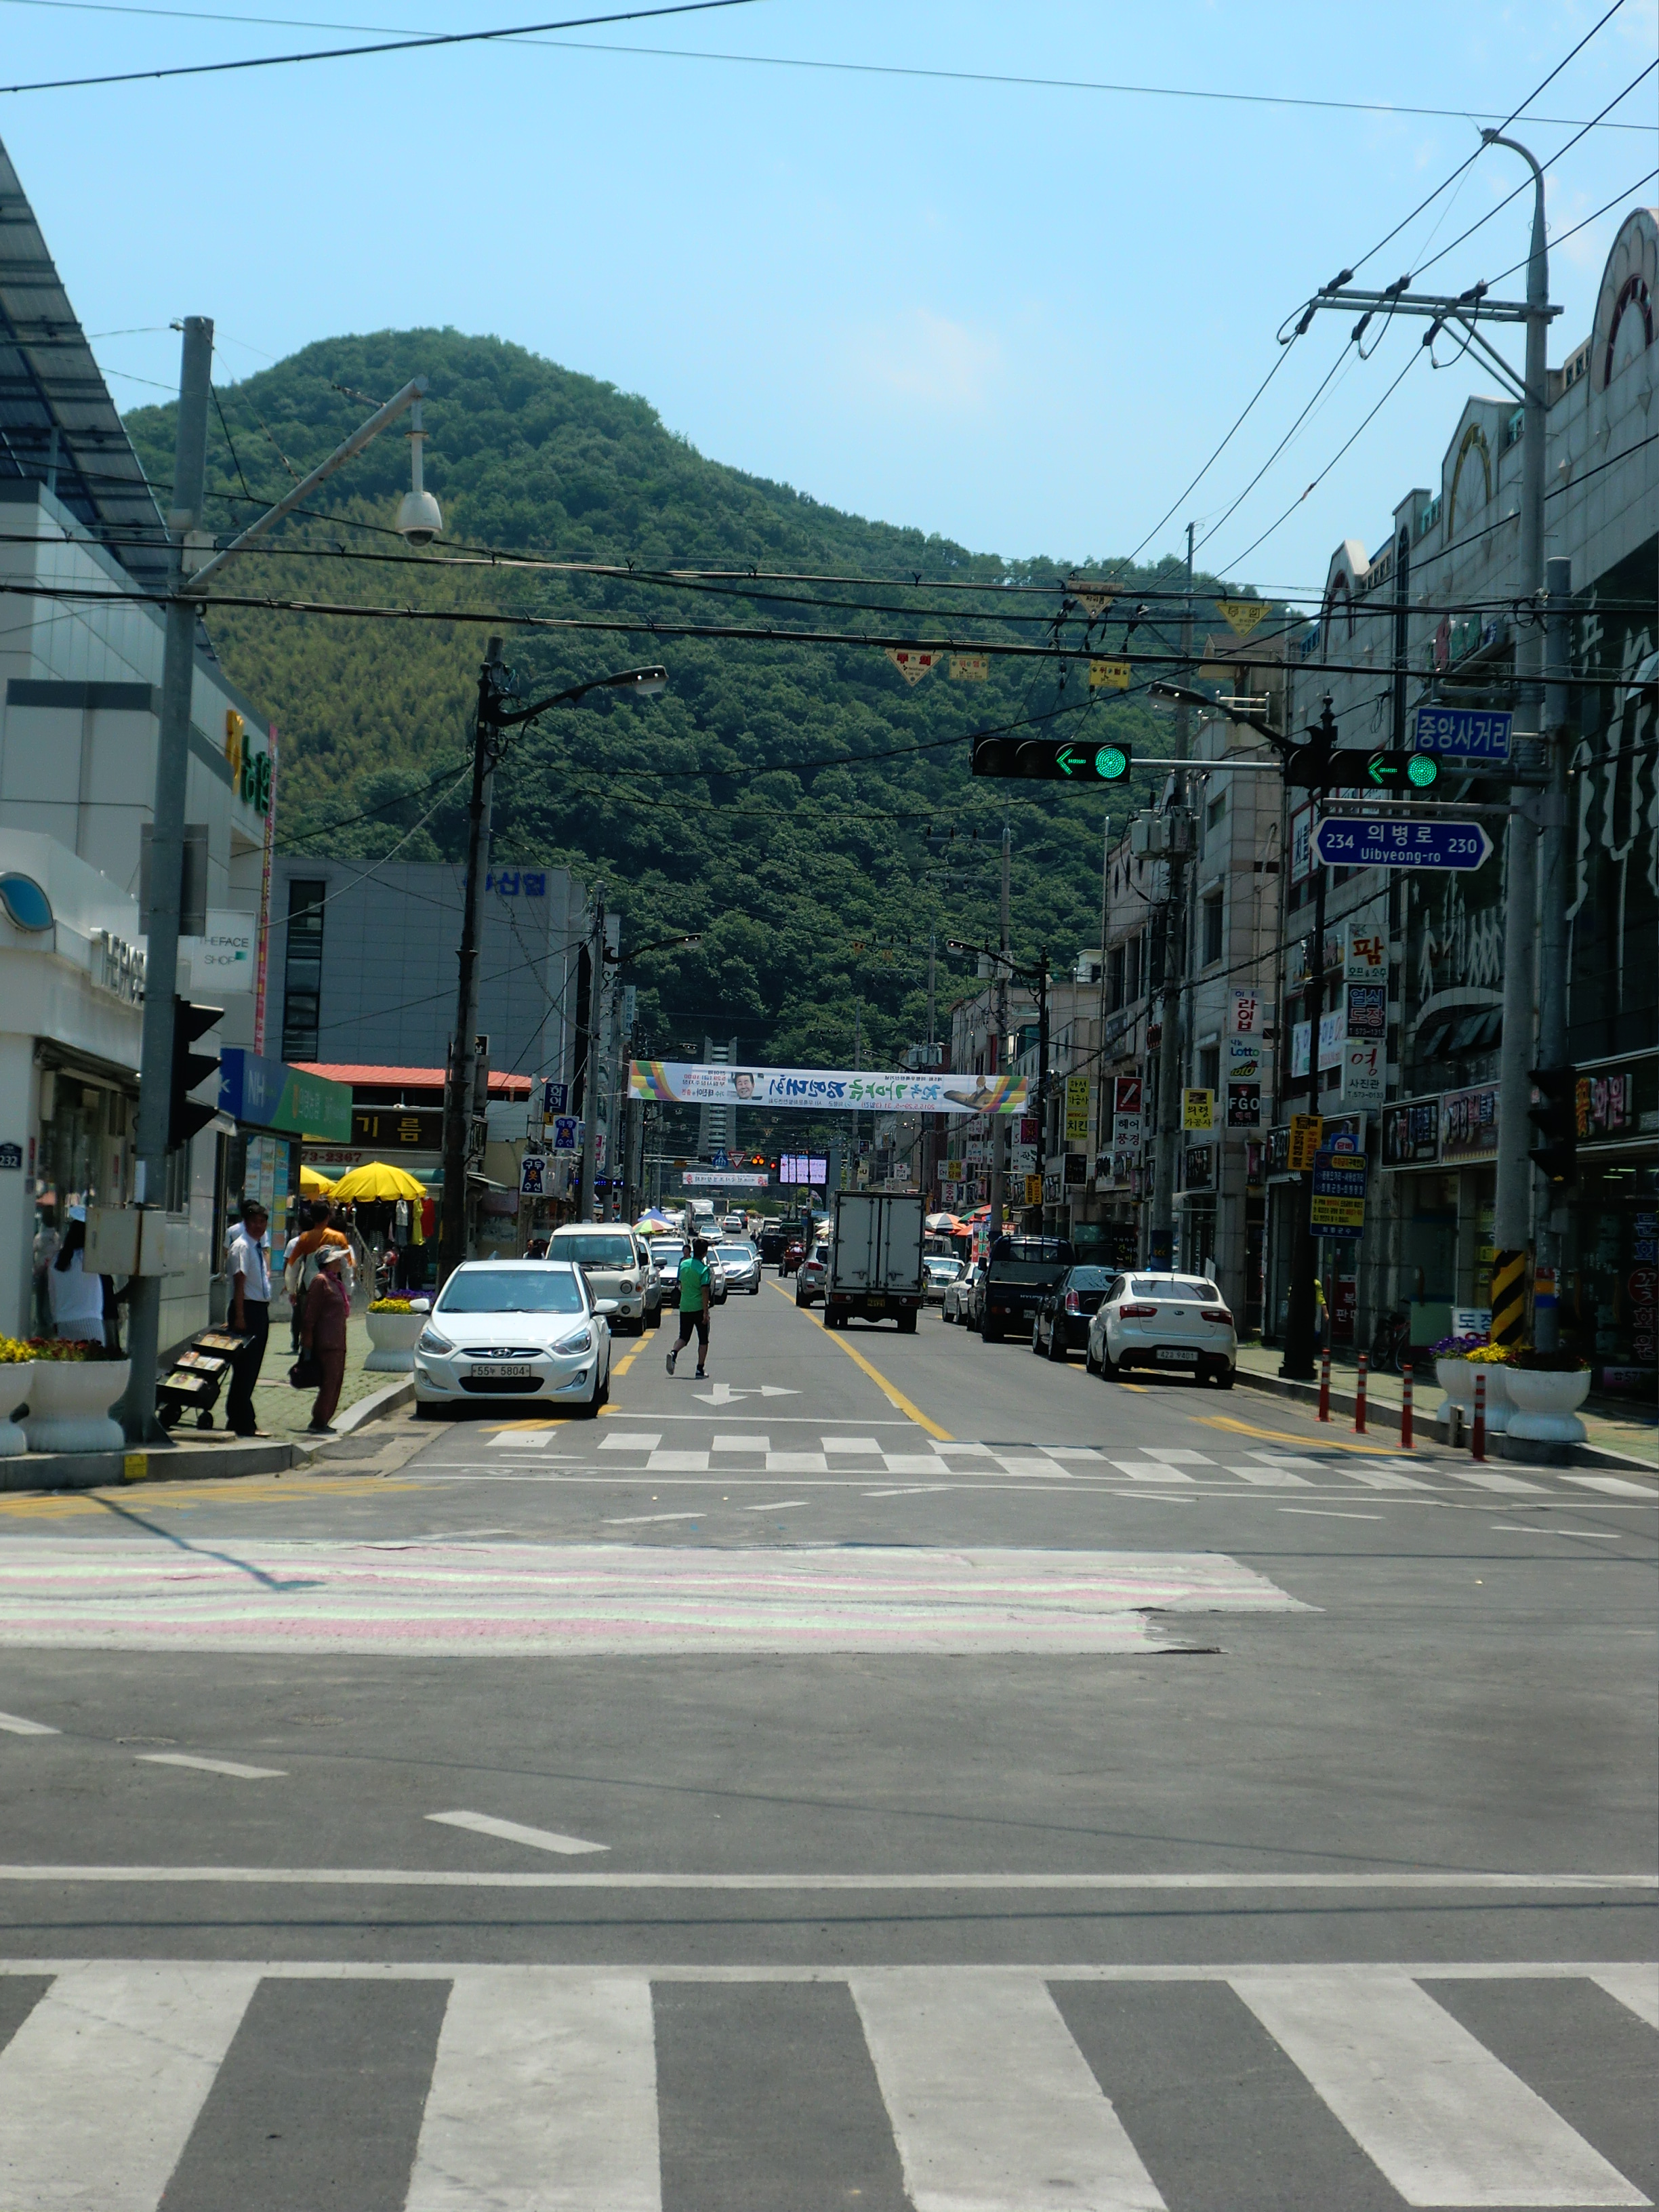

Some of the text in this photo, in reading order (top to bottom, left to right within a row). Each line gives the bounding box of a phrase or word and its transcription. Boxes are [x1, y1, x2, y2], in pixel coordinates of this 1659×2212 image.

[1418, 715, 1512, 753] 중앙사거리
[1367, 824, 1434, 844] 의병로
[1326, 833, 1355, 850] 234
[1448, 838, 1477, 855] 230
[1360, 846, 1441, 863] Uibyeong-ro
[1353, 937, 1385, 966] 팜
[1349, 987, 1384, 1007] 열쇠
[1237, 998, 1258, 1032] 라이브
[1349, 1008, 1385, 1026] 도장
[1231, 1047, 1260, 1057] Lotto
[1351, 1048, 1378, 1076] 영
[1350, 1079, 1380, 1090] 사진관
[1187, 1105, 1209, 1116] 의령
[1229, 1097, 1260, 1111] FGO
[356, 1115, 423, 1142] 기름
[1067, 1120, 1088, 1132] 치킨
[1118, 1119, 1139, 1130] 헤어
[1184, 1118, 1212, 1128] 가공사
[1116, 1133, 1140, 1146] 풍경
[0, 1155, 18, 1166] 232
[525, 1160, 542, 1170] 구두
[524, 1182, 542, 1192] 수선
[500, 1366, 525, 1376] 5804
